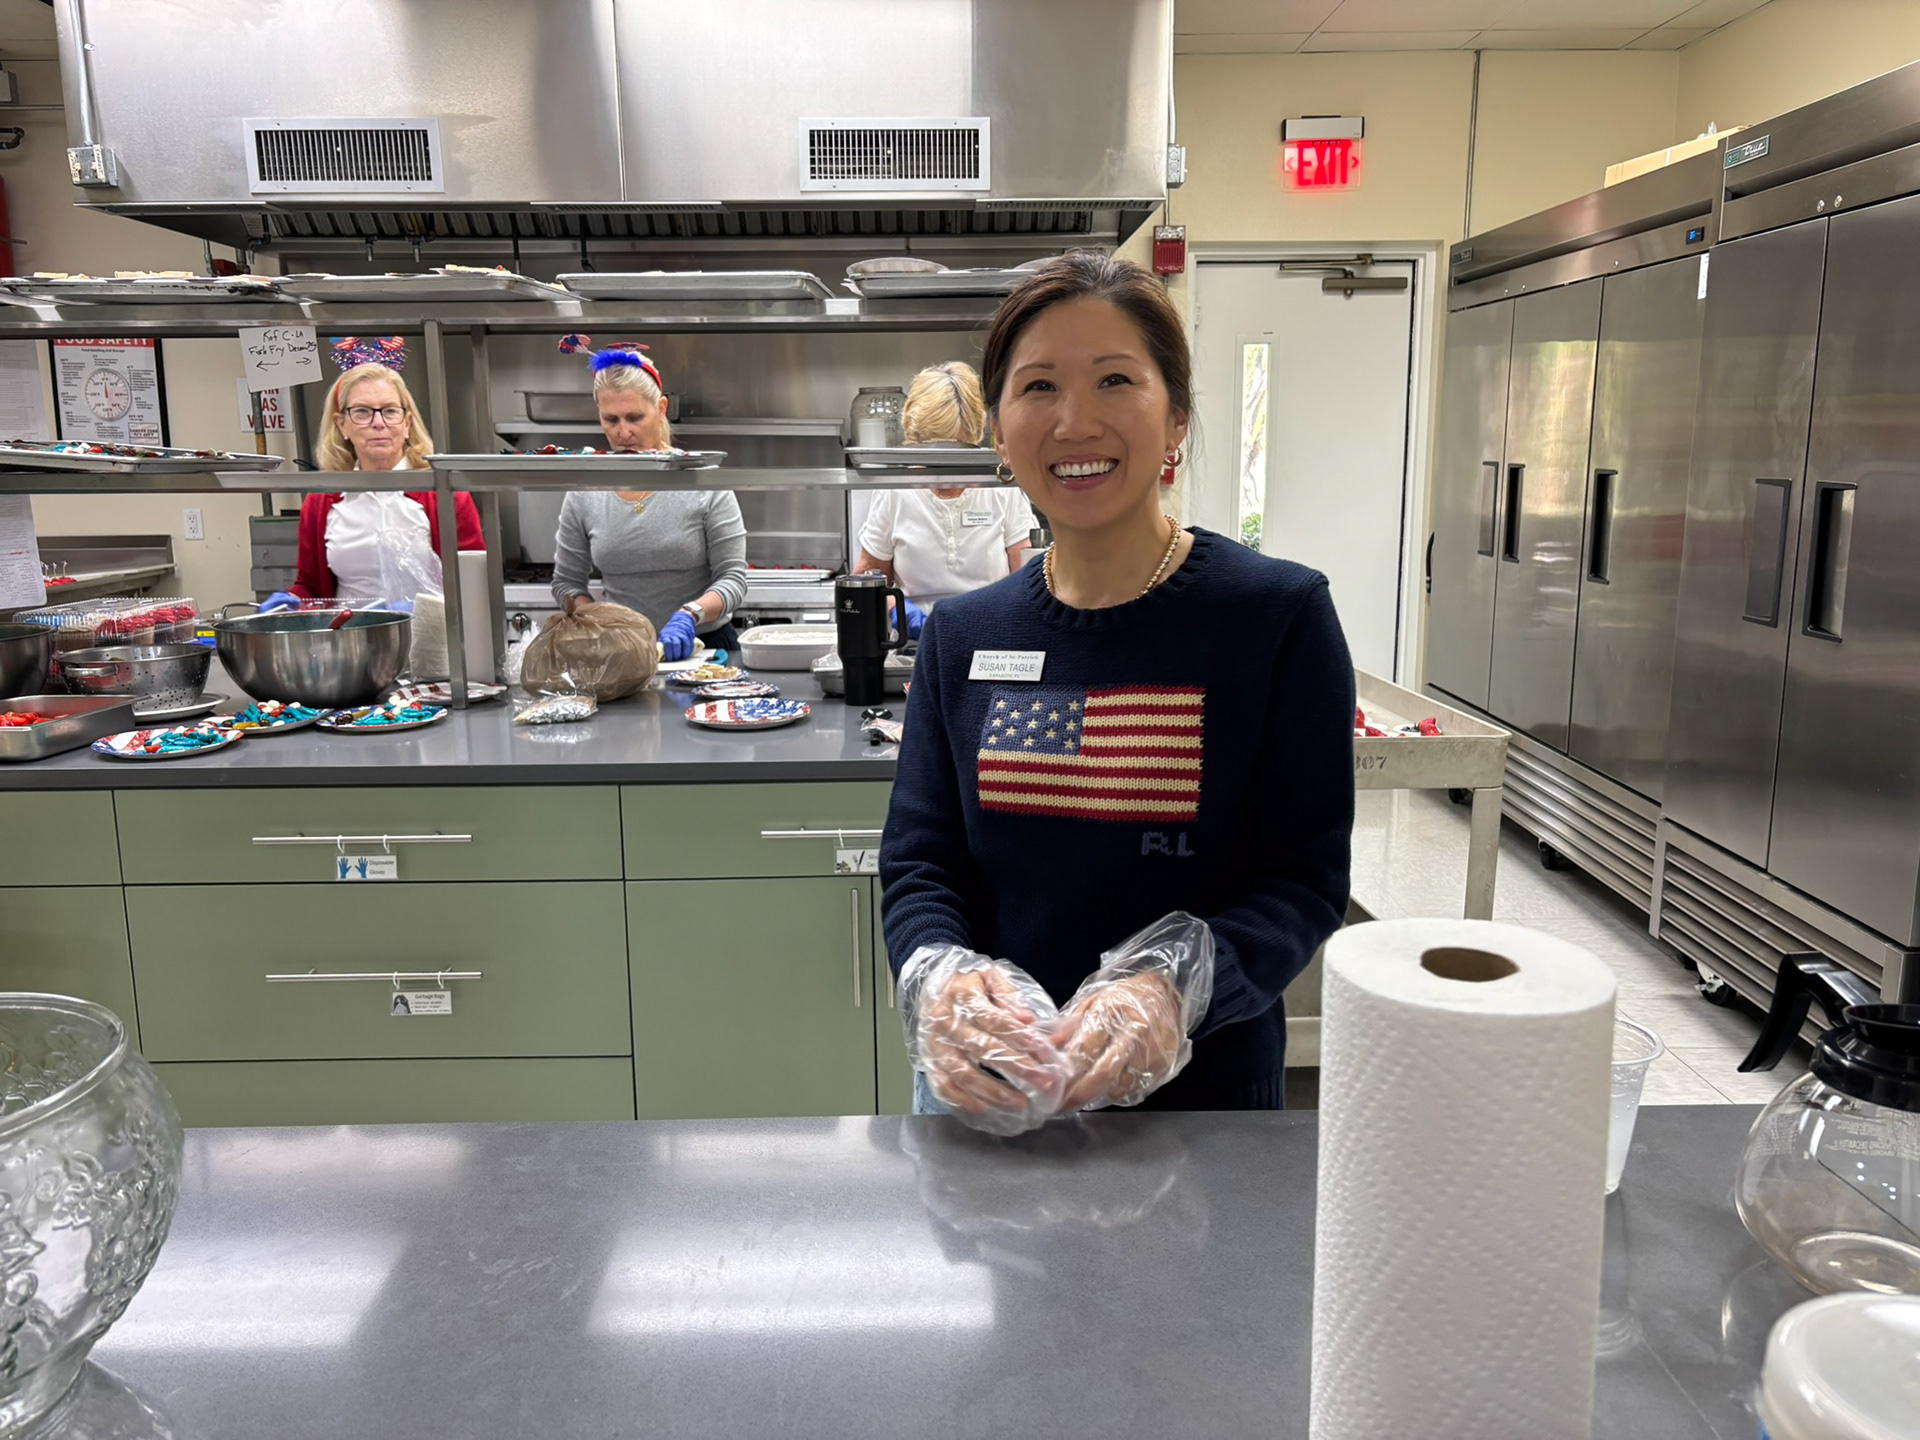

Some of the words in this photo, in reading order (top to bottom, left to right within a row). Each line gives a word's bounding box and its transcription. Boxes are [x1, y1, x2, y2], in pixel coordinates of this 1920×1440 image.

[1297, 140, 1352, 186] EXIT
[261, 397, 278, 412] AS
[247, 414, 285, 429] VLVE
[978, 662, 1006, 671] SUSAN
[1009, 663, 1035, 672] TAGLE
